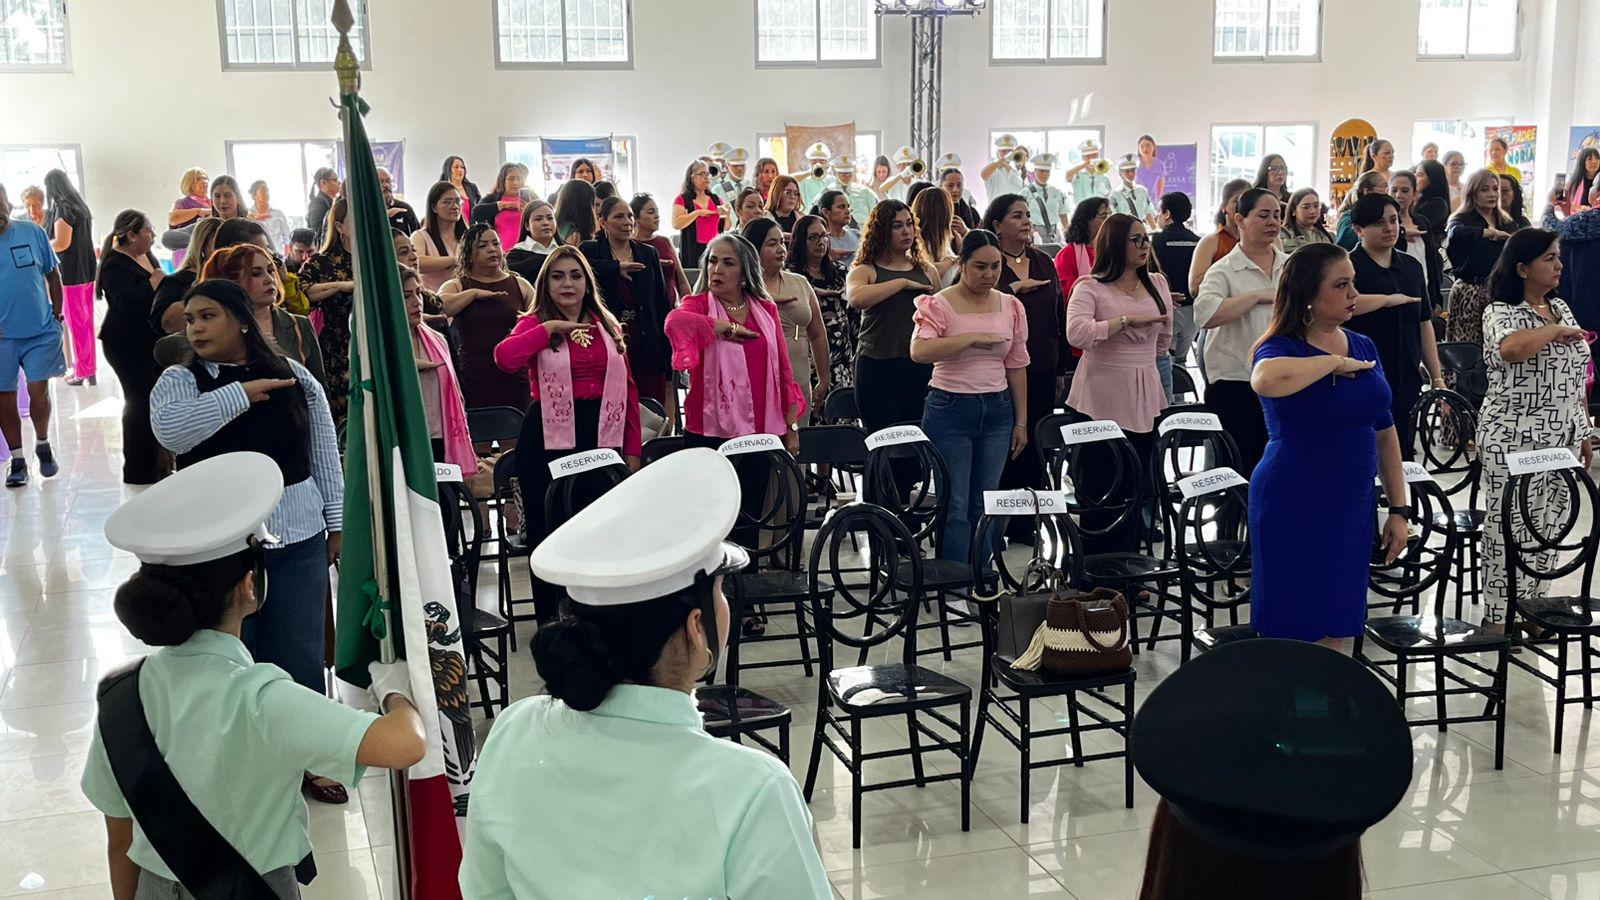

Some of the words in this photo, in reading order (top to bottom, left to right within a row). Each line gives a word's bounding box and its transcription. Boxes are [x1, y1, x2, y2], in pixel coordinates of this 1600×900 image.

[1165, 417, 1212, 427] RESERVADO
[874, 429, 922, 443] RESERVADO
[1072, 424, 1119, 436] RESERVADO
[722, 438, 774, 452] RESERVADO
[560, 452, 615, 470] RESERVADO
[1517, 453, 1571, 466] RESERVADO
